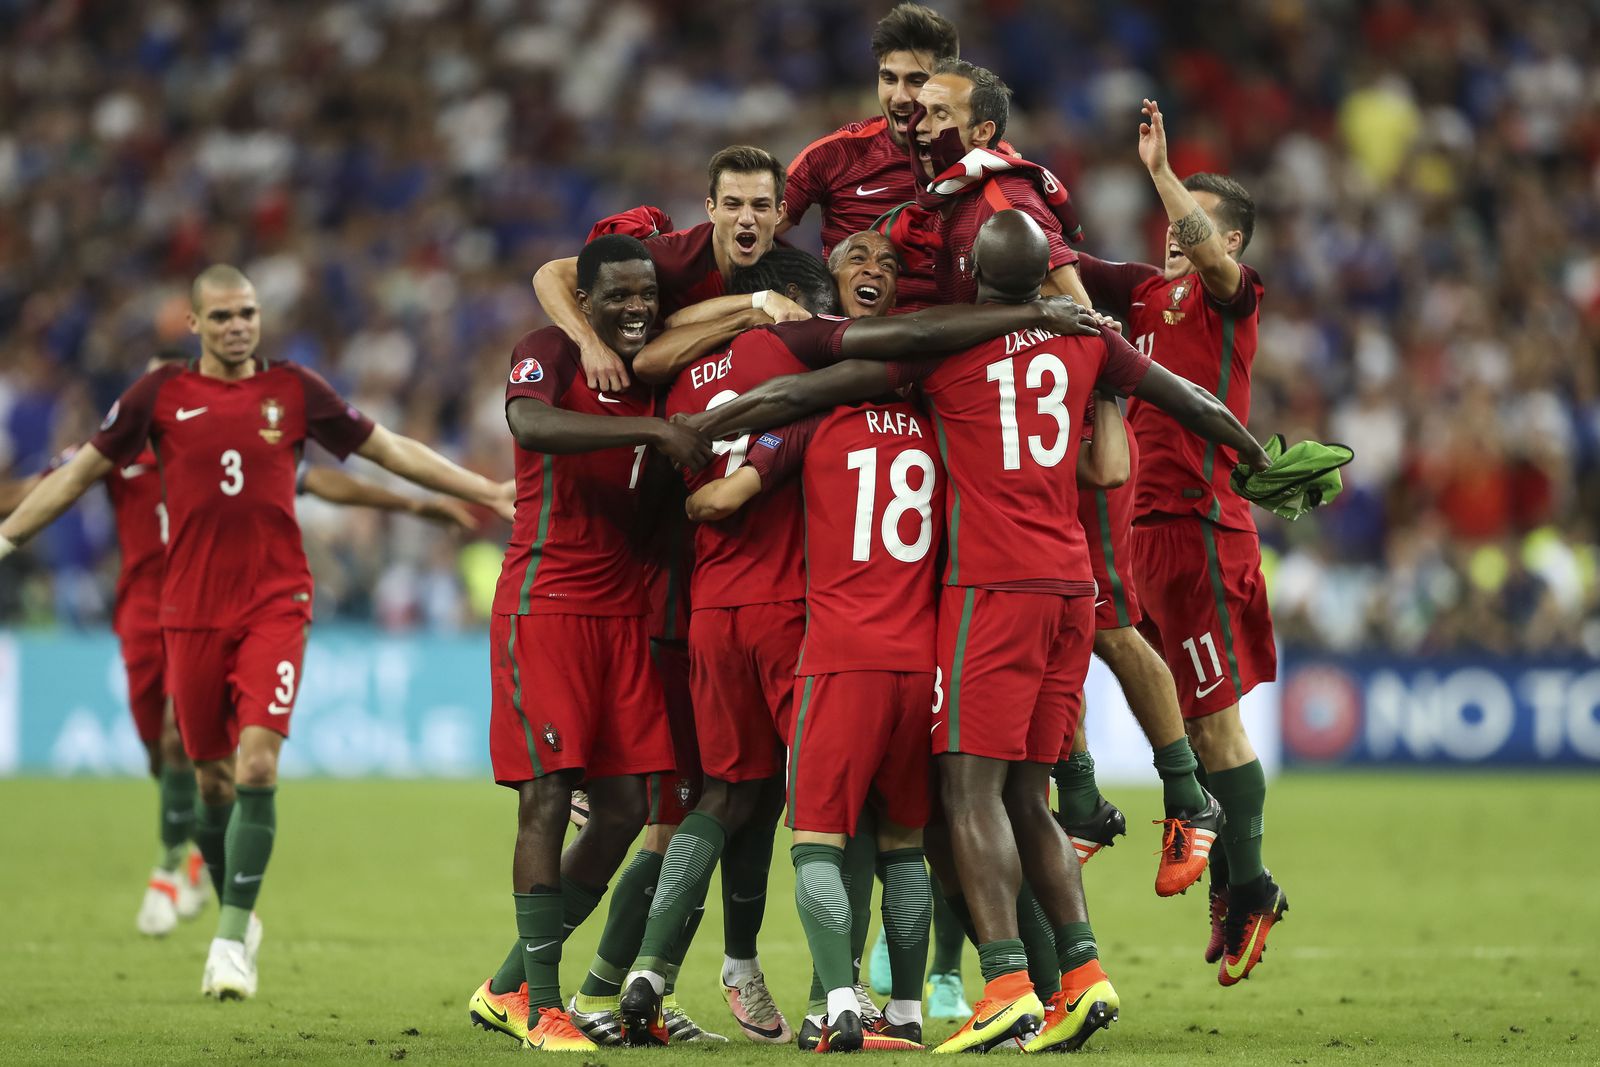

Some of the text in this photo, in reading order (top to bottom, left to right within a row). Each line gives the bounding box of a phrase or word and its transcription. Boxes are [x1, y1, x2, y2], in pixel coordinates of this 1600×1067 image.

[1005, 328, 1061, 354] DANIL
[1136, 332, 1155, 358] 11
[690, 349, 733, 390] EDER
[865, 410, 923, 438] RAFA
[986, 353, 1071, 471] 13
[759, 435, 780, 447] ESPECT
[219, 449, 245, 496] 3
[847, 447, 936, 563] 18
[1182, 631, 1223, 683] 11
[275, 660, 296, 703] 3
[1363, 668, 1514, 759] NO
